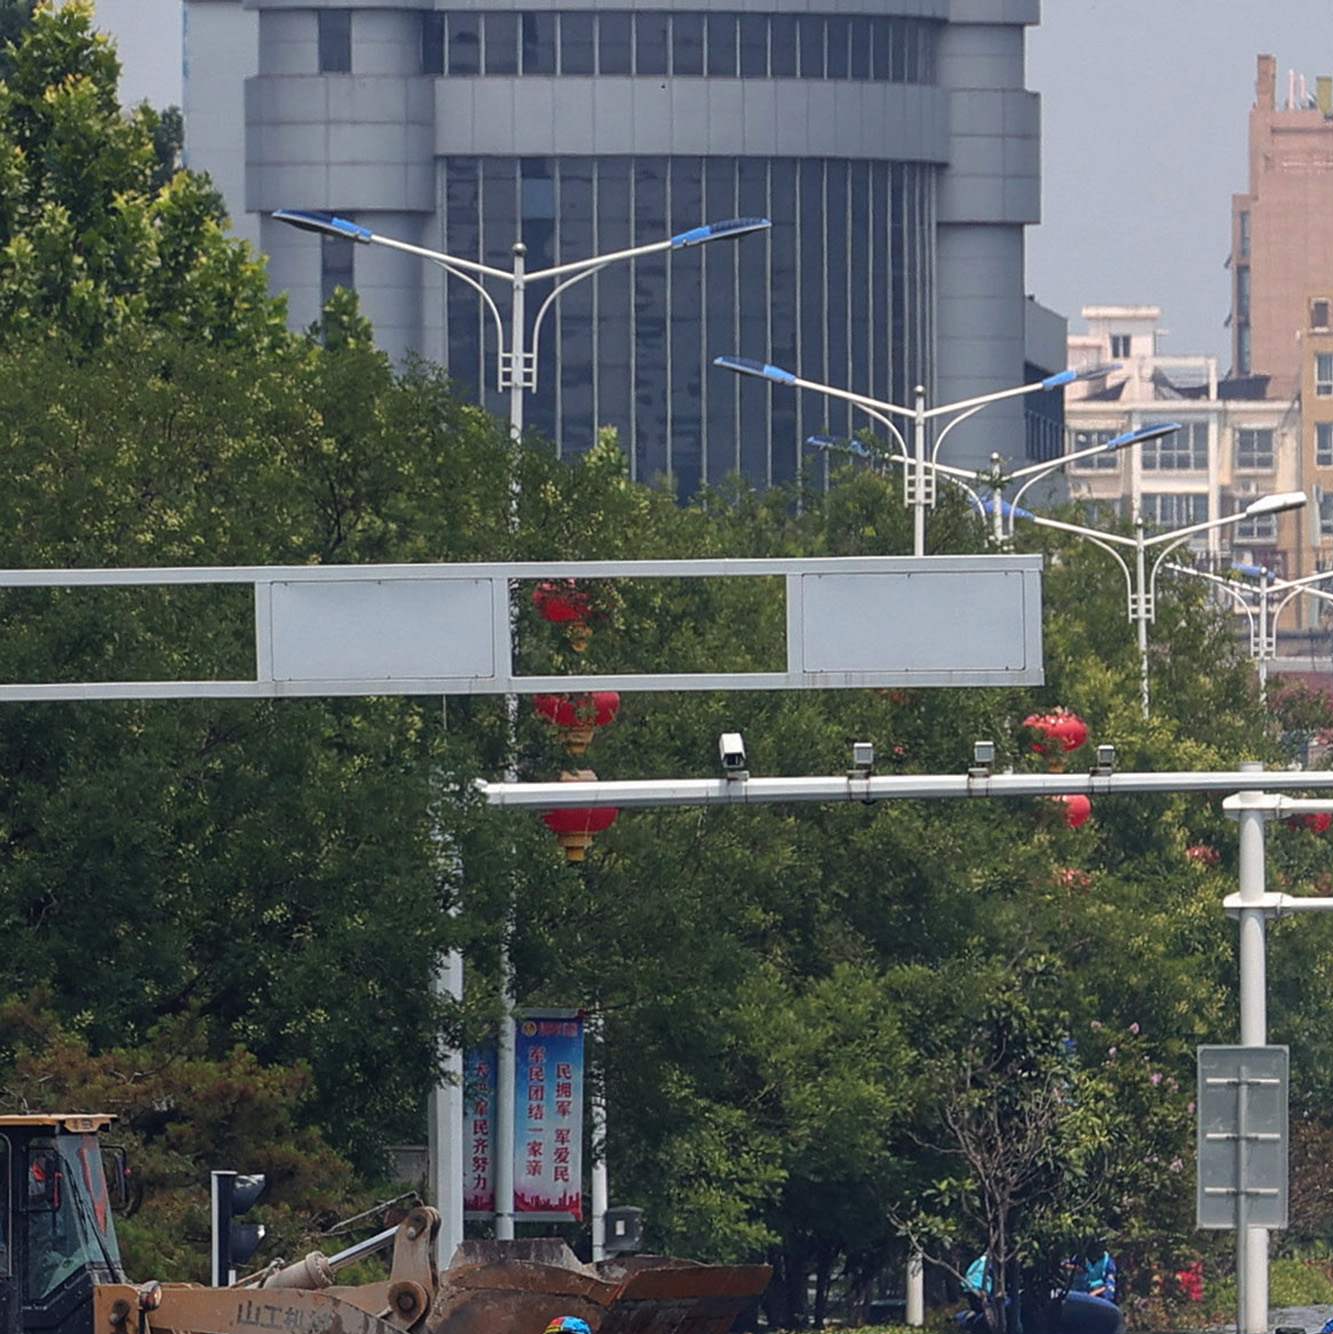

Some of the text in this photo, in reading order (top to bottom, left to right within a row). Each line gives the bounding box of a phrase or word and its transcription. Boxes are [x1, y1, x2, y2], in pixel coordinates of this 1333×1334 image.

[526, 1046, 546, 1177] 军民团结一家亲
[553, 1063, 573, 1183] 民拥军 军爱民
